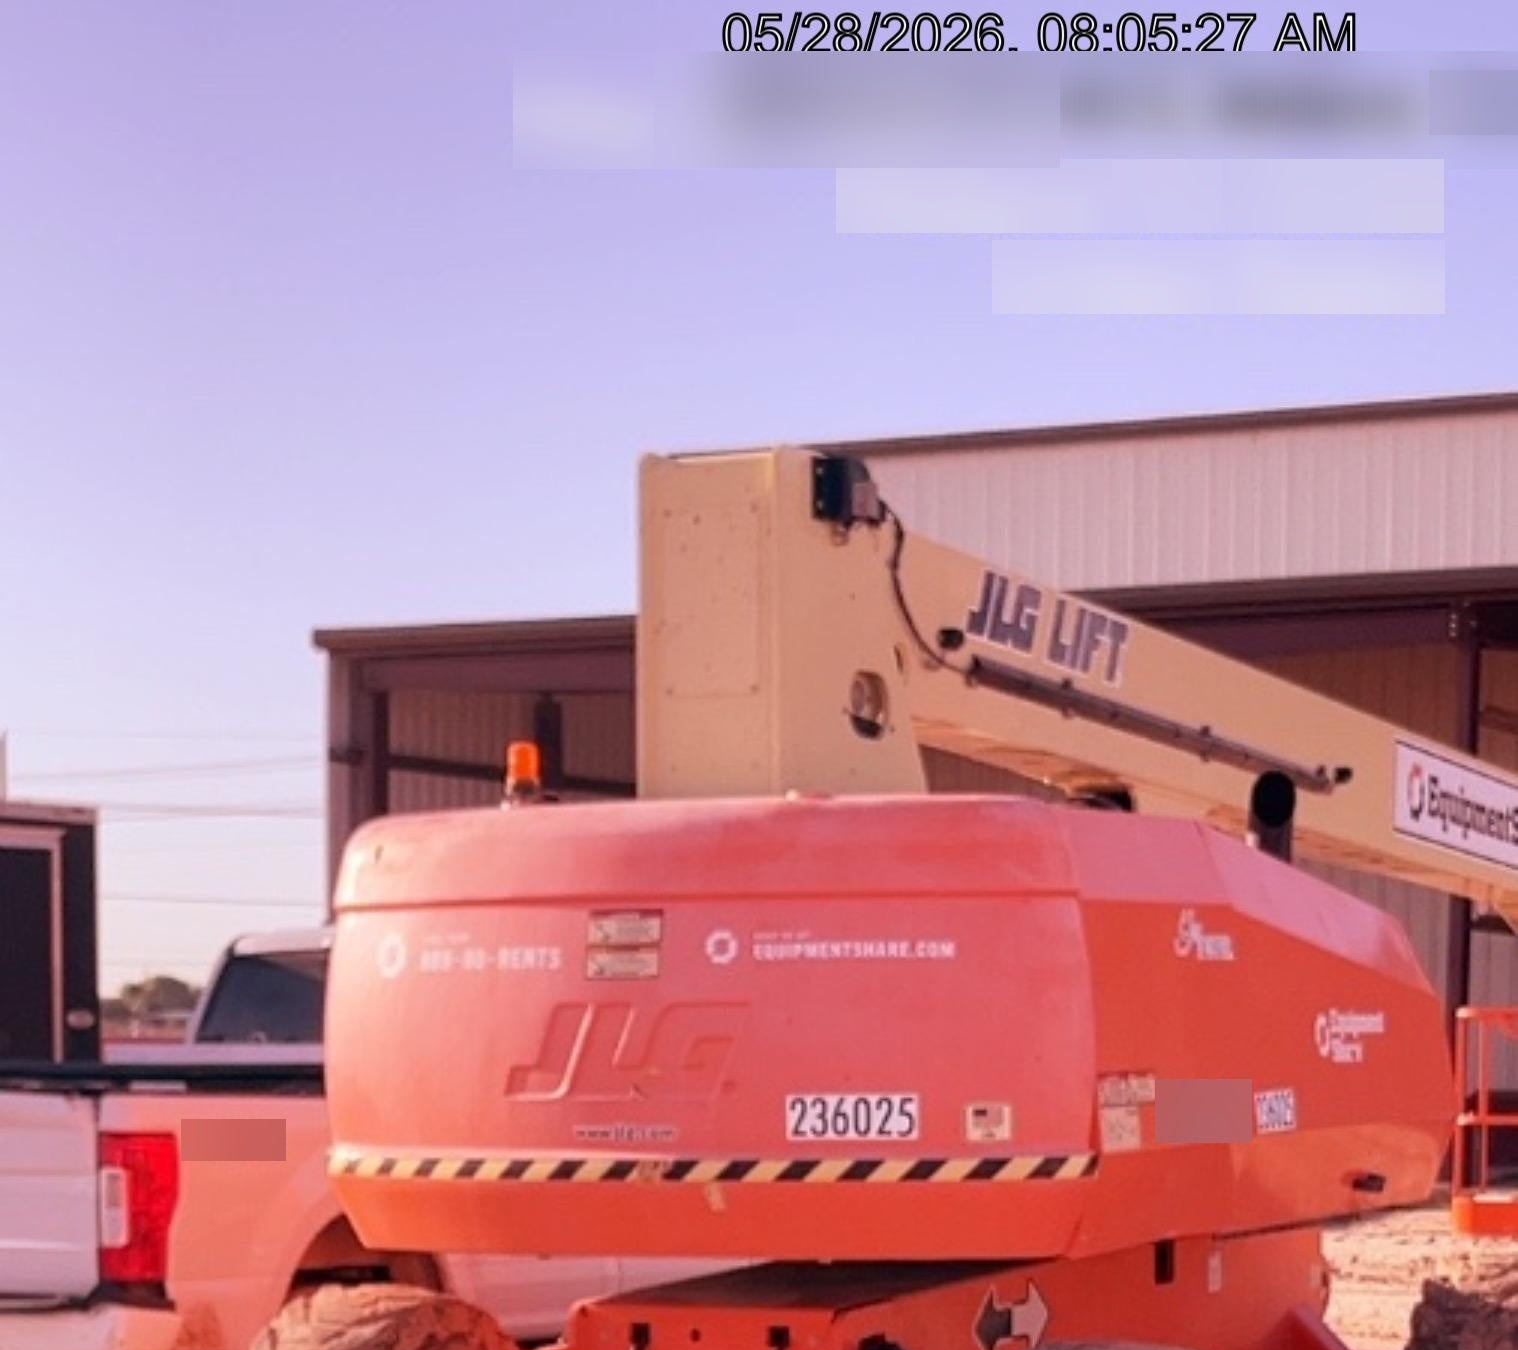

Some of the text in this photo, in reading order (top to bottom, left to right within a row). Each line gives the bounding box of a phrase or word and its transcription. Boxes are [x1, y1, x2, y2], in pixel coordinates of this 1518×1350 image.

[967, 569, 1129, 686] JLG LIFT
[752, 940, 957, 962] EQUIPMENTSHARE.COM
[504, 1001, 750, 1102] JLG
[788, 1097, 915, 1138] 236025
